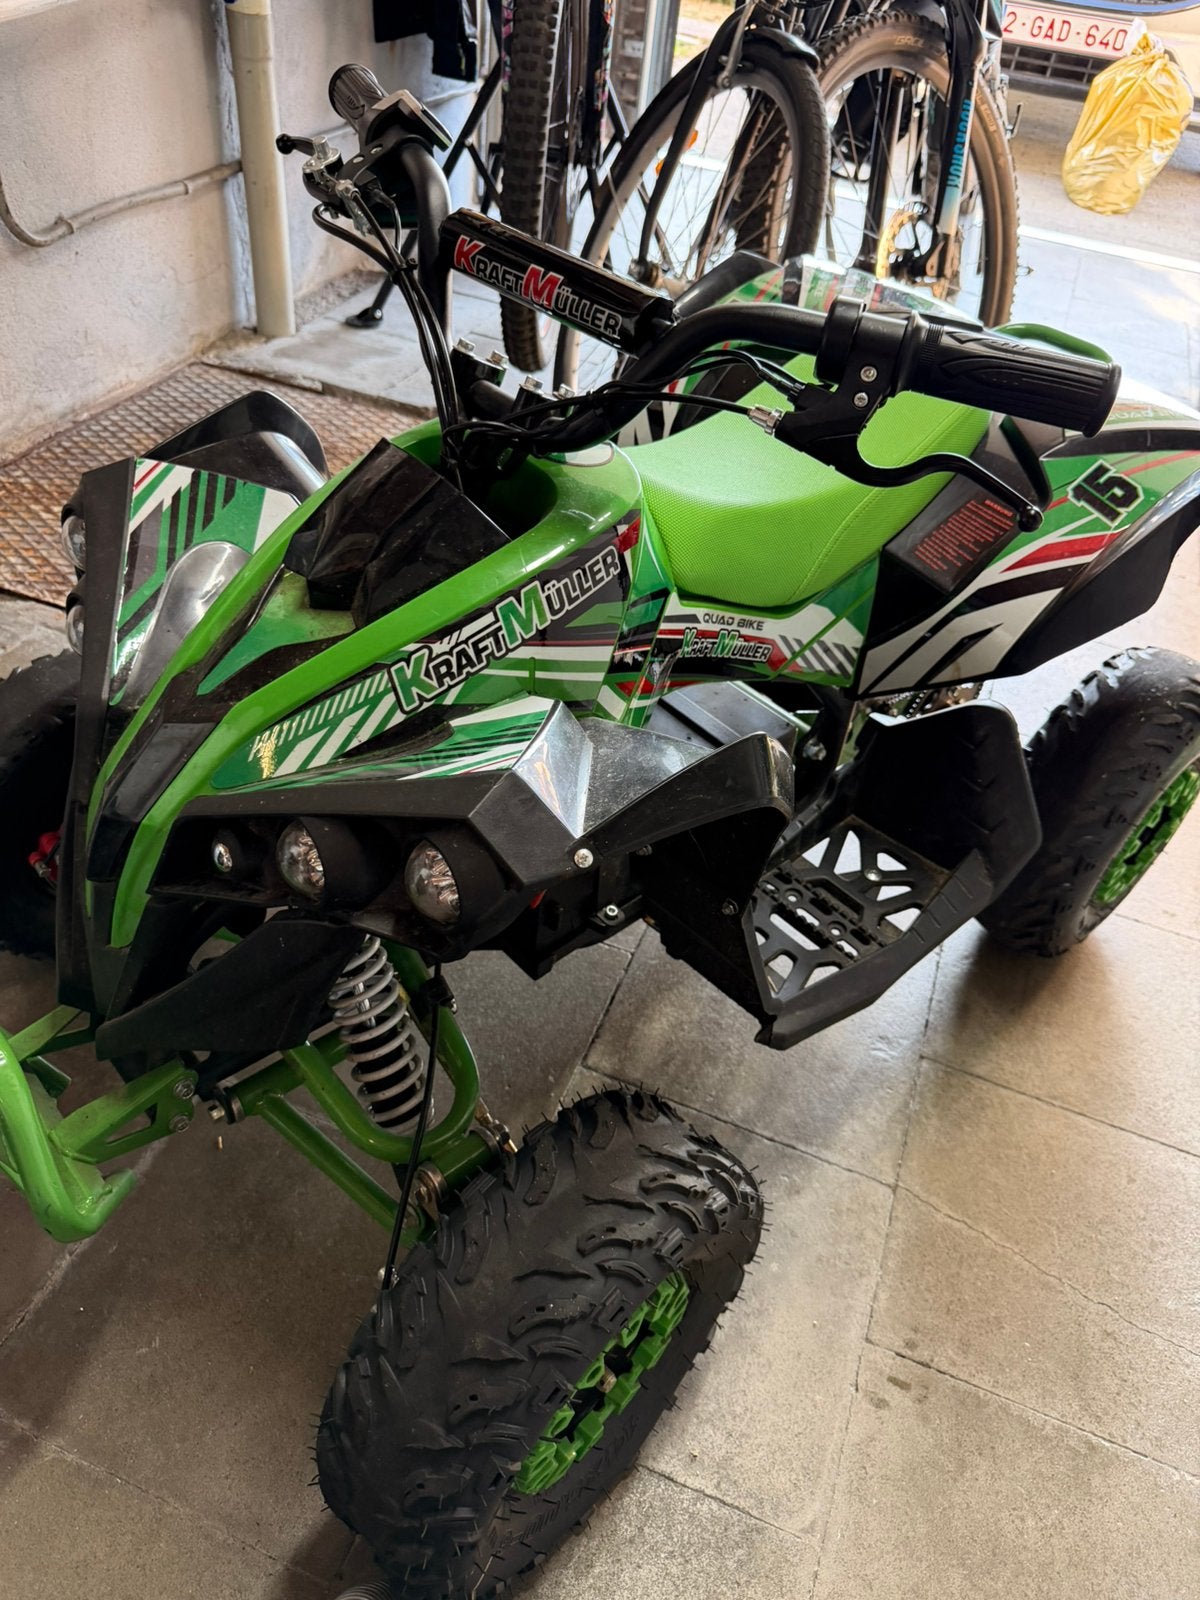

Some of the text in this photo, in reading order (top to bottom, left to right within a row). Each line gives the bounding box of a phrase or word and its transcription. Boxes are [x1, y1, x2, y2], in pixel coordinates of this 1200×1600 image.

[454, 234, 623, 339] KRAFTMÜLLER
[1067, 460, 1144, 527] 15
[389, 546, 621, 713] KRAFTMÜLLER
[702, 612, 765, 631] QUAD BIKE
